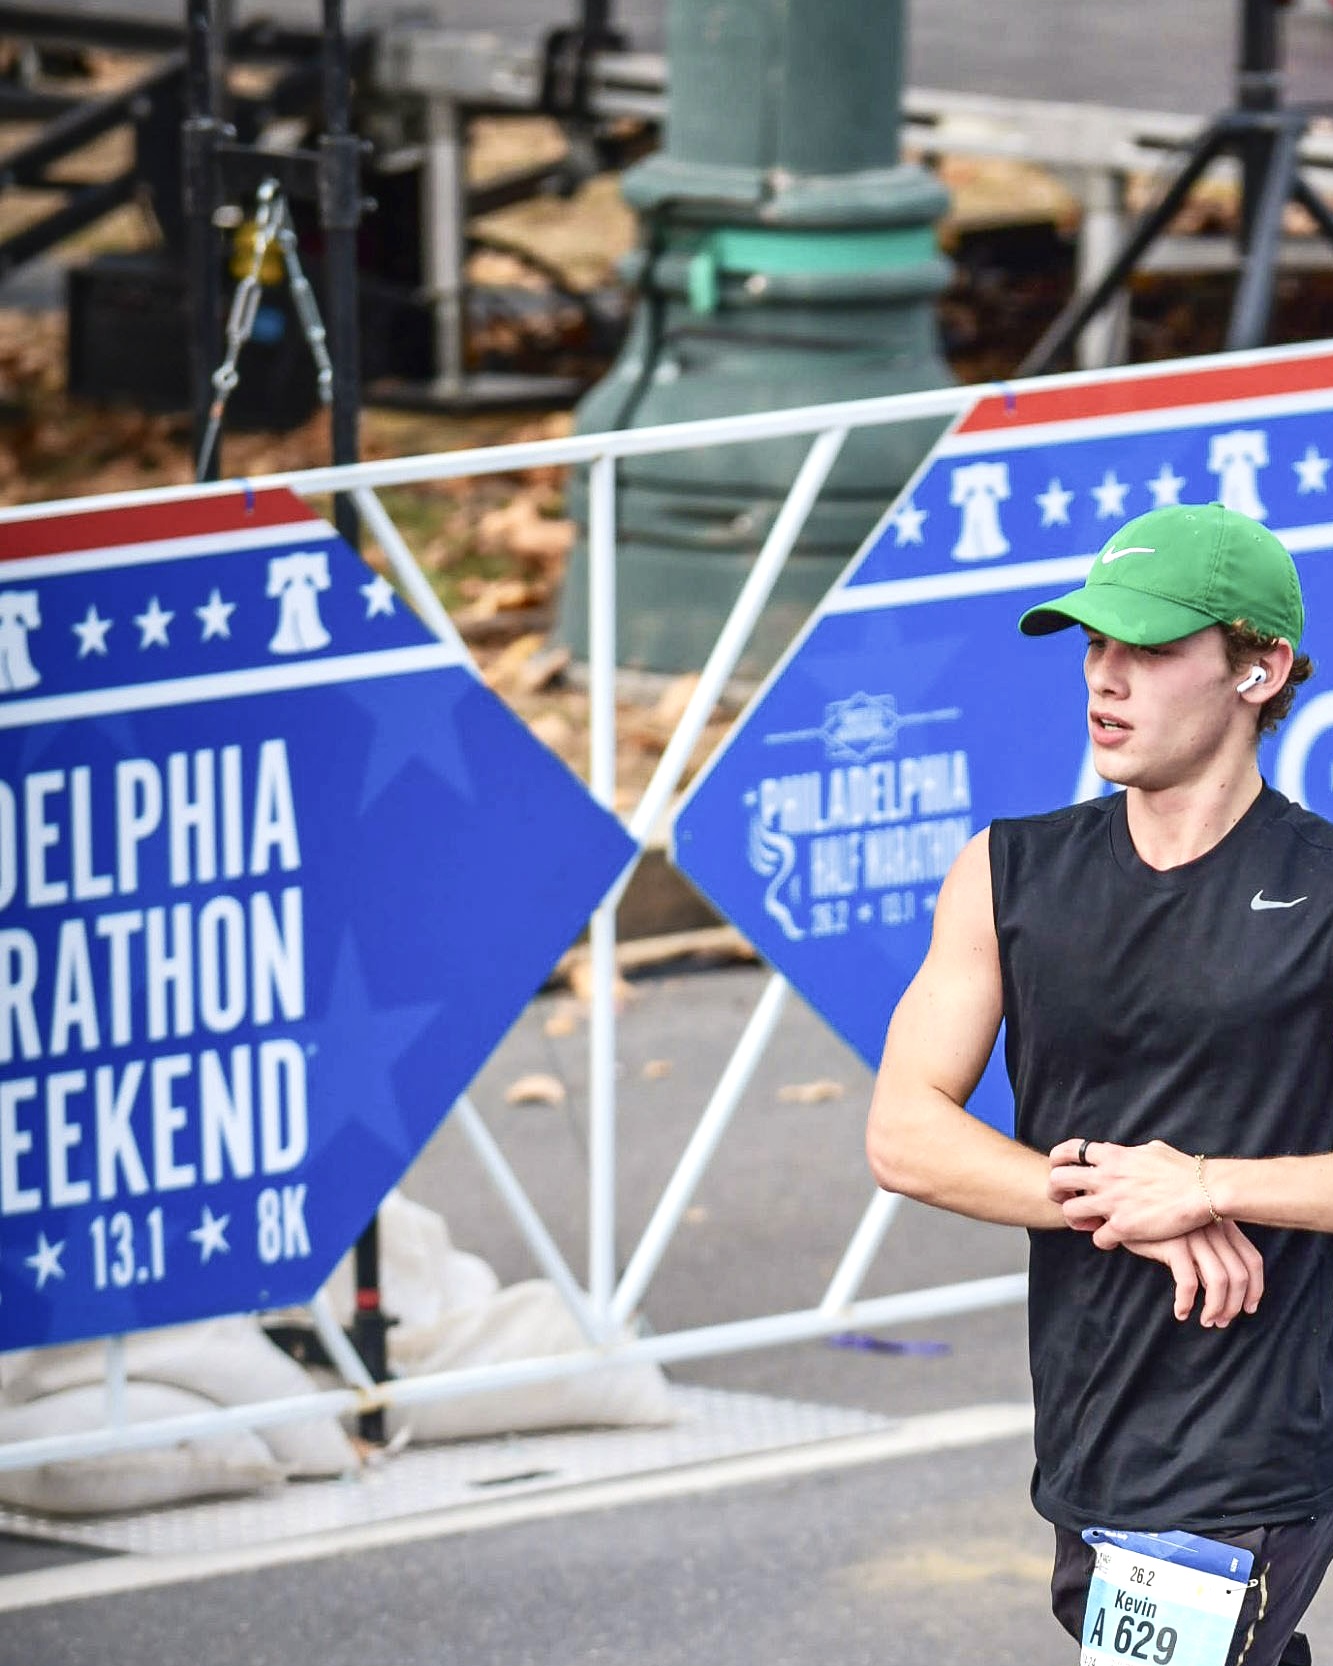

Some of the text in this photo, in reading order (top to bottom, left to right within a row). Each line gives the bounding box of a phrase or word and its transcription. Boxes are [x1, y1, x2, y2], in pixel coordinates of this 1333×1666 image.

[0, 1038, 308, 1216] EEKEND
[90, 1183, 311, 1290] 13.1 8K
[1114, 1588, 1157, 1619] Kevin
[1130, 1566, 1155, 1587] 26.2
[1089, 1607, 1178, 1666] A 629
